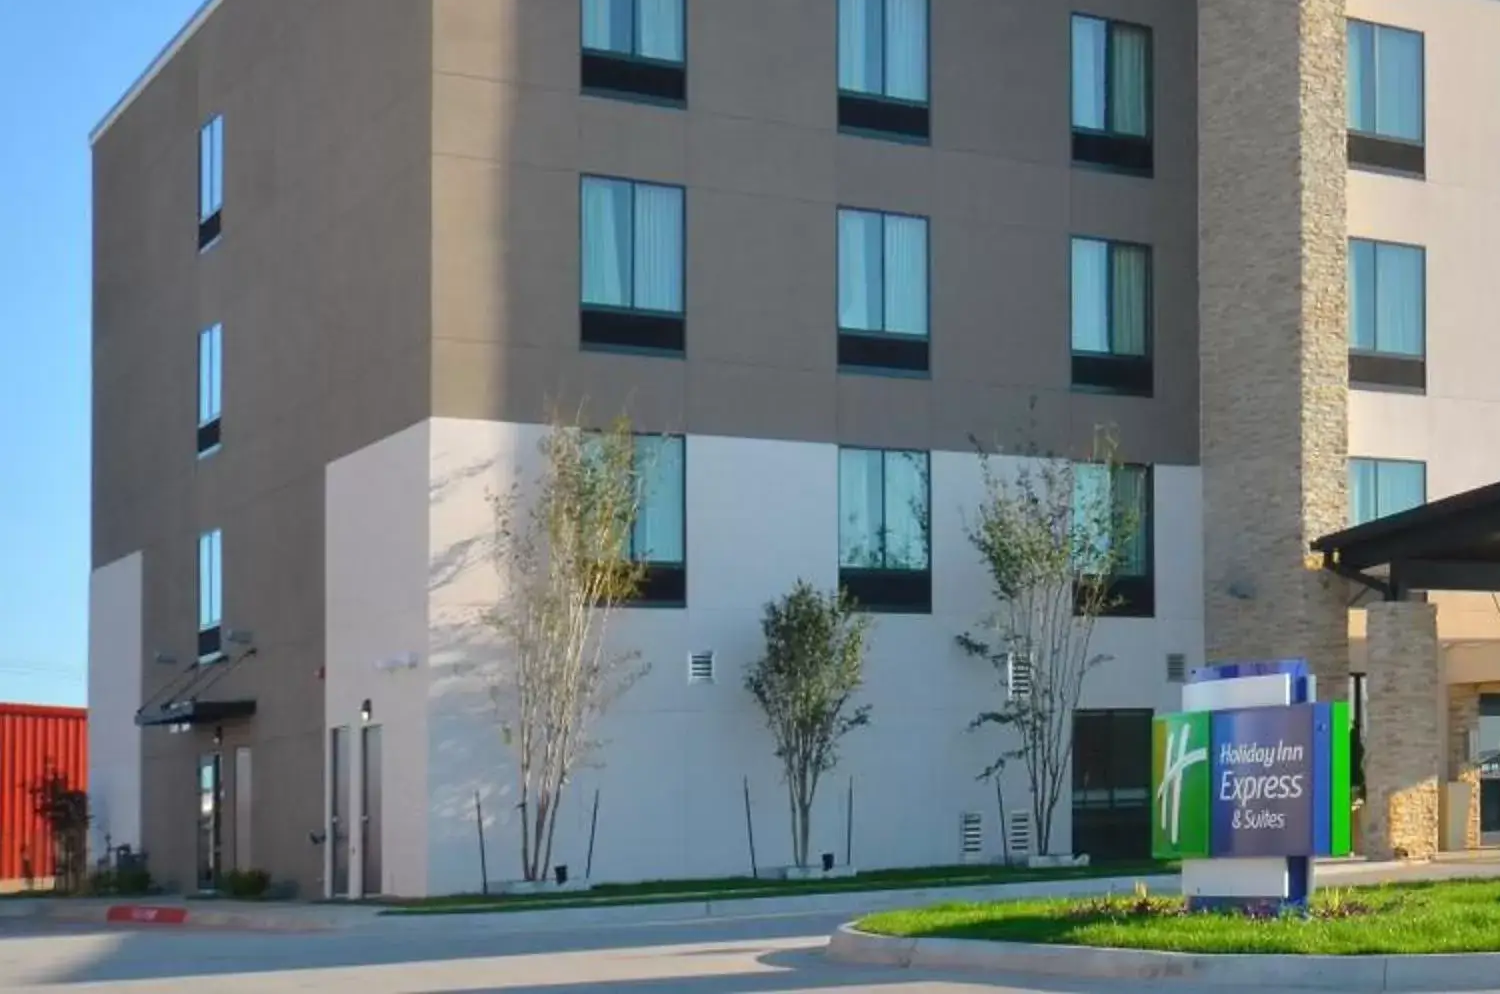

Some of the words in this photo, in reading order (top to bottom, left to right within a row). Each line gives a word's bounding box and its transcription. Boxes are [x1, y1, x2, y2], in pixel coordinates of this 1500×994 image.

[1219, 742, 1275, 767] Holiday
[1276, 739, 1304, 762] Inn
[1219, 770, 1304, 806] Express
[1231, 812, 1242, 829] &
[1243, 809, 1286, 829] Suites
